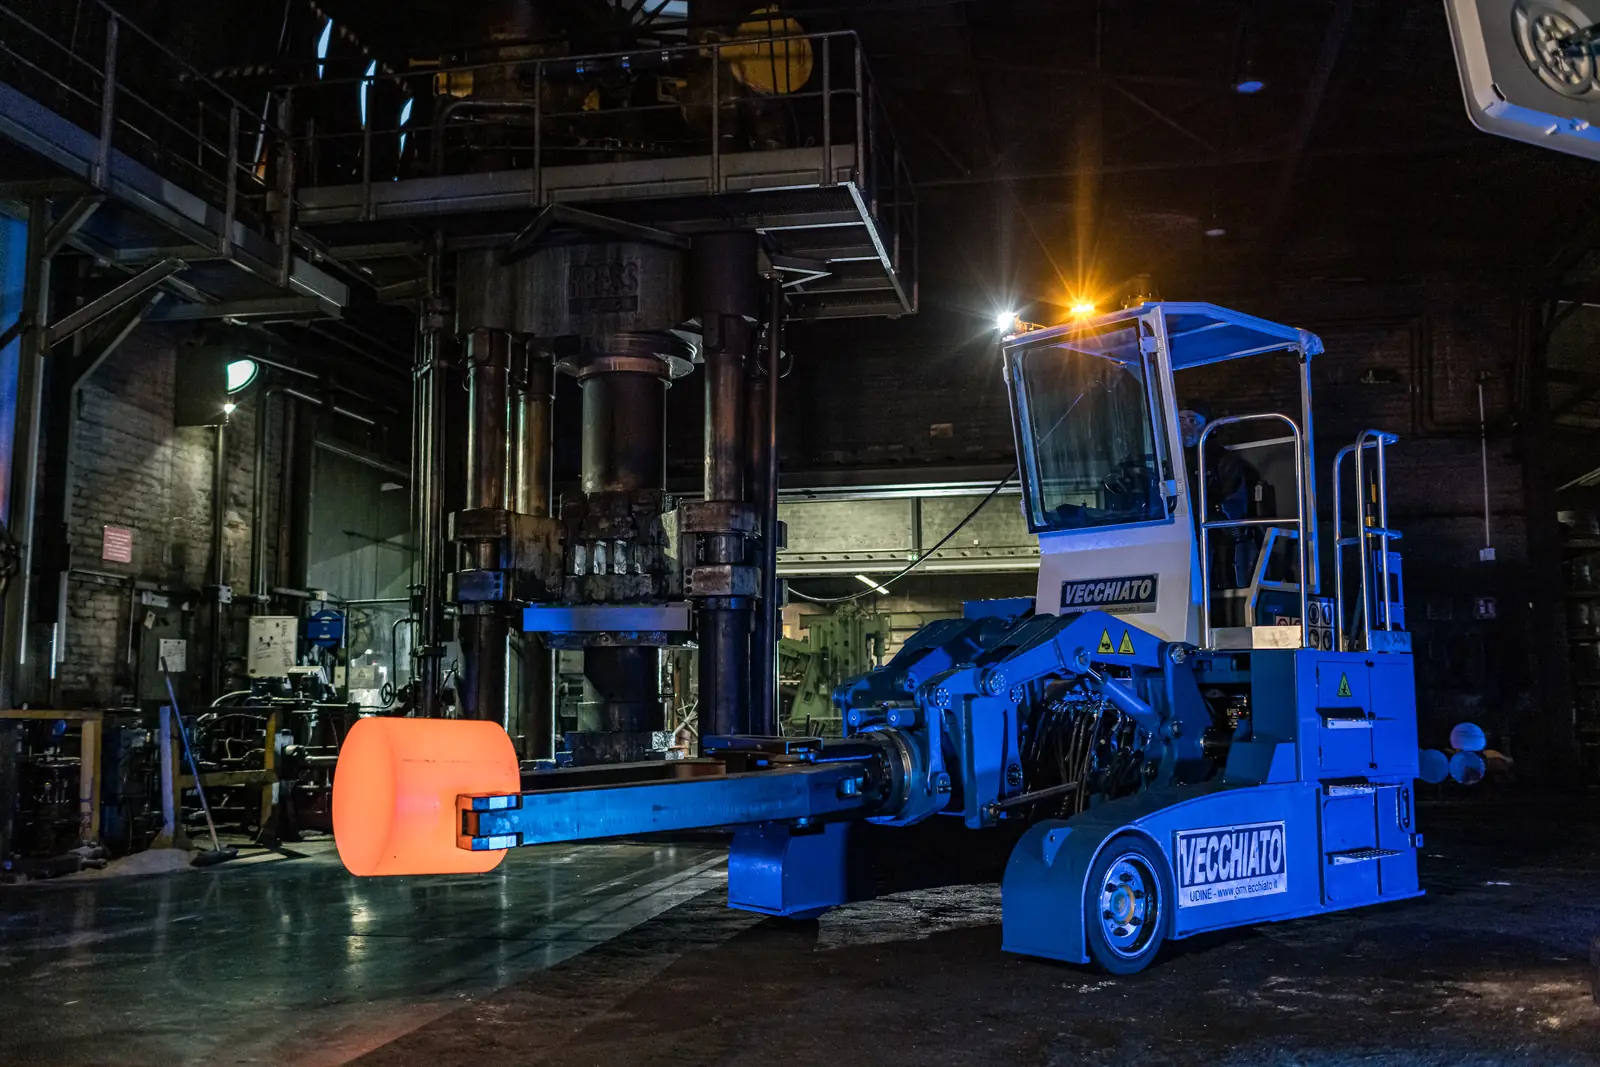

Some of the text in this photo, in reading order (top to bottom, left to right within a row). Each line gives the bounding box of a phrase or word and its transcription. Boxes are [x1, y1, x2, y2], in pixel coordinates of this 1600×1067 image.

[1065, 579, 1152, 604] VECCHIATO
[1180, 828, 1282, 886] VECCHIATO
[1189, 888, 1212, 902] UDINE
